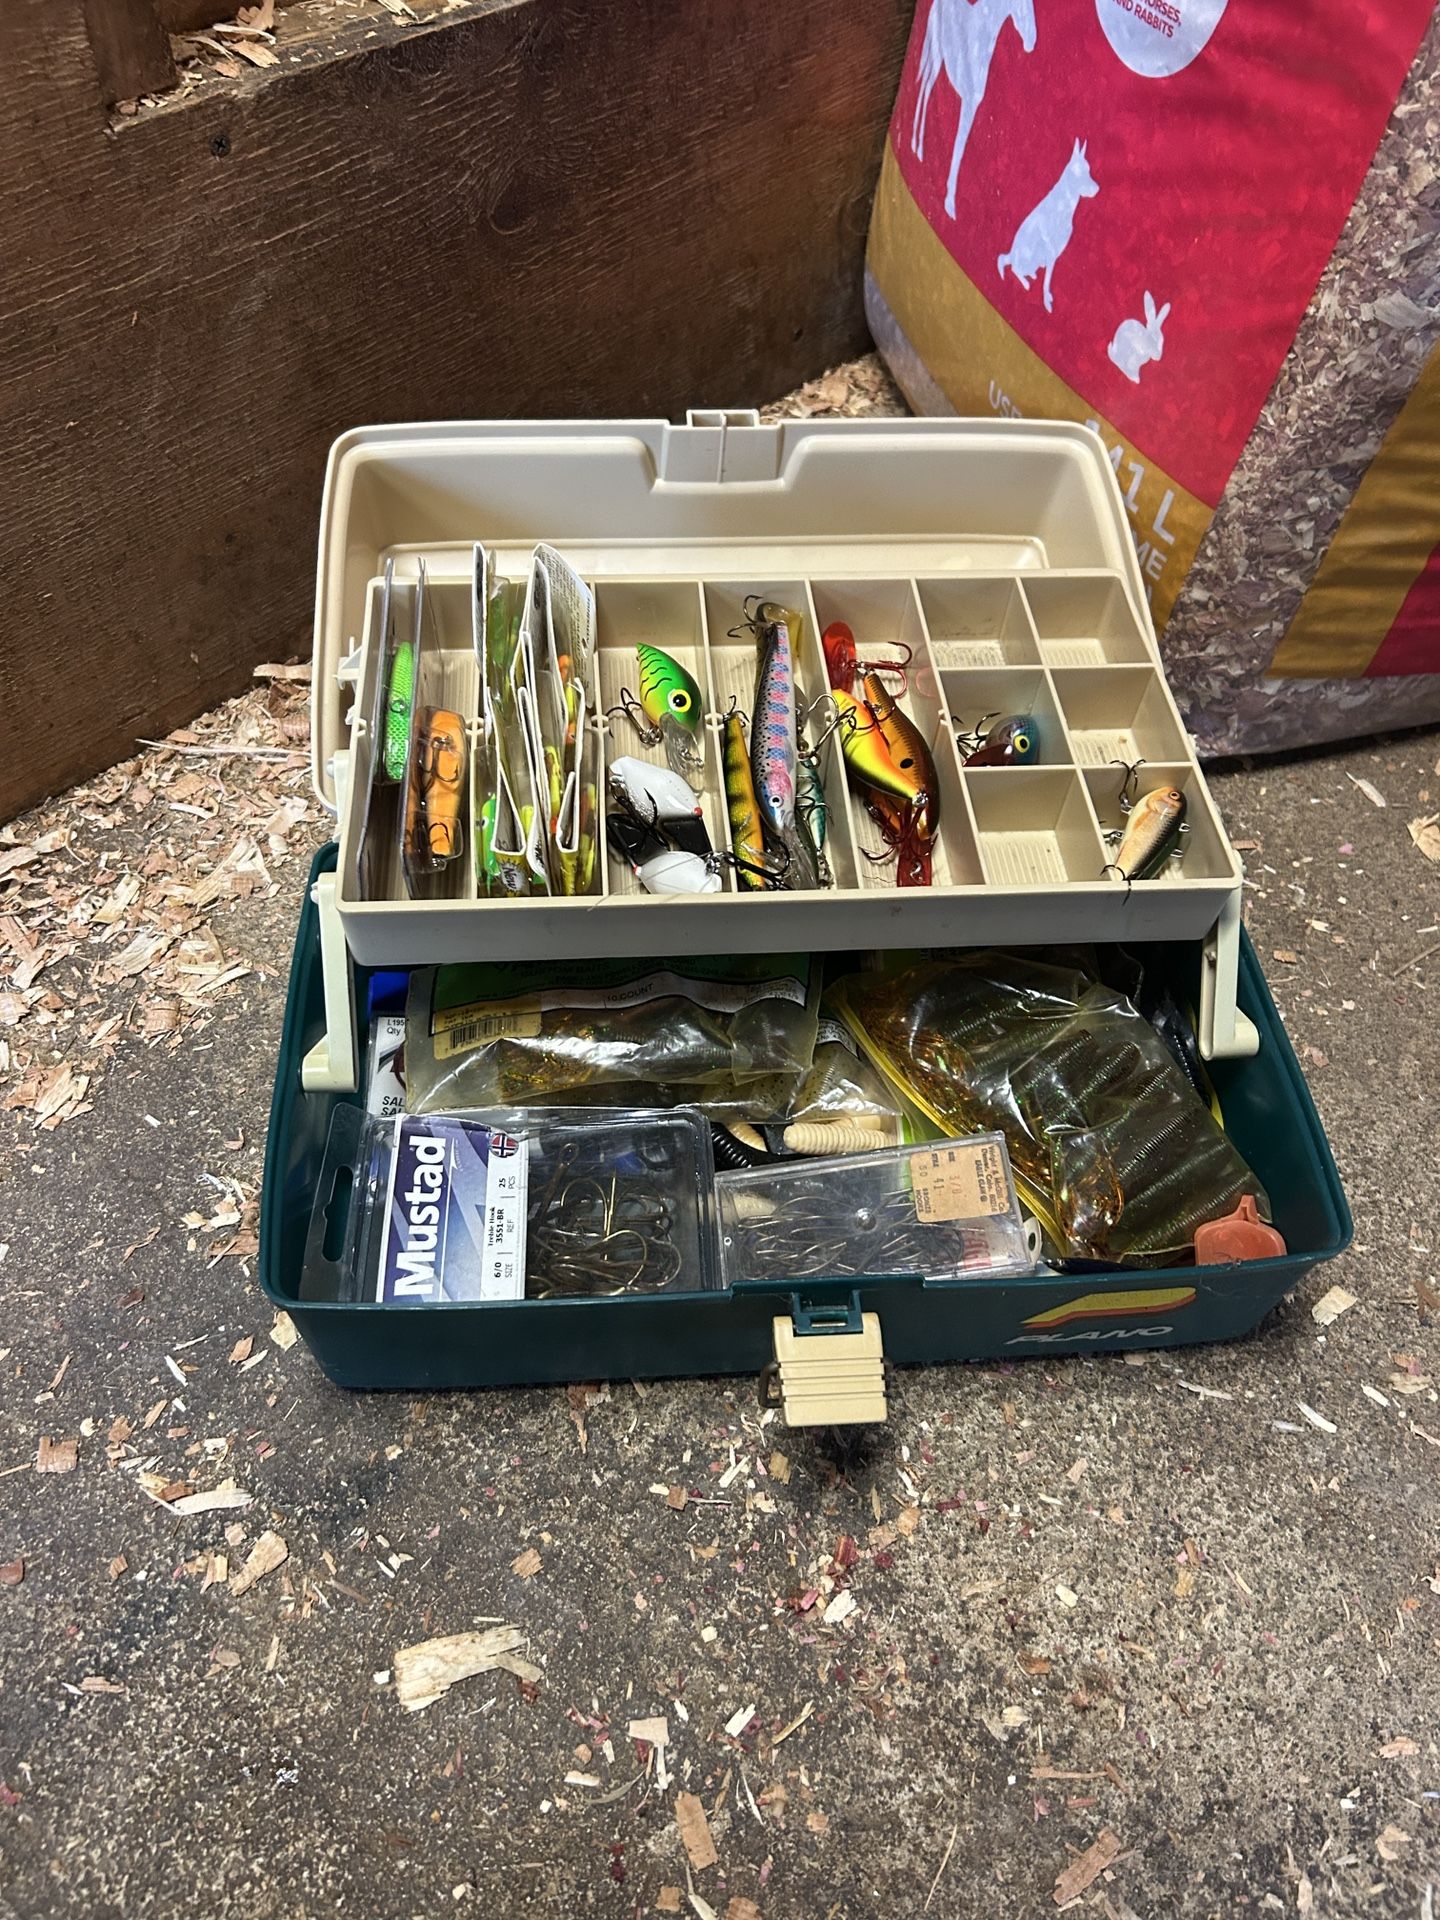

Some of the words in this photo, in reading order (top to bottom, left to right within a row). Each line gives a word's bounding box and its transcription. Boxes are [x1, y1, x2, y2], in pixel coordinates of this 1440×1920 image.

[1134, 4, 1174, 38] RABBITS
[1144, 0, 1182, 27] ORSES,
[1152, 489, 1175, 546] L
[620, 983, 655, 1000] COUNT
[387, 1026, 401, 1036] Qty
[382, 1095, 405, 1107] SAL
[498, 1177, 506, 1188] 25
[508, 1175, 516, 1190] PCS
[393, 1135, 447, 1297] Mustad
[496, 1208, 505, 1244] 3551-BR
[506, 1219, 515, 1233] REF
[493, 1261, 503, 1279] 6/0
[504, 1263, 513, 1278] SIZE
[1004, 1326, 1174, 1345] PLANO
